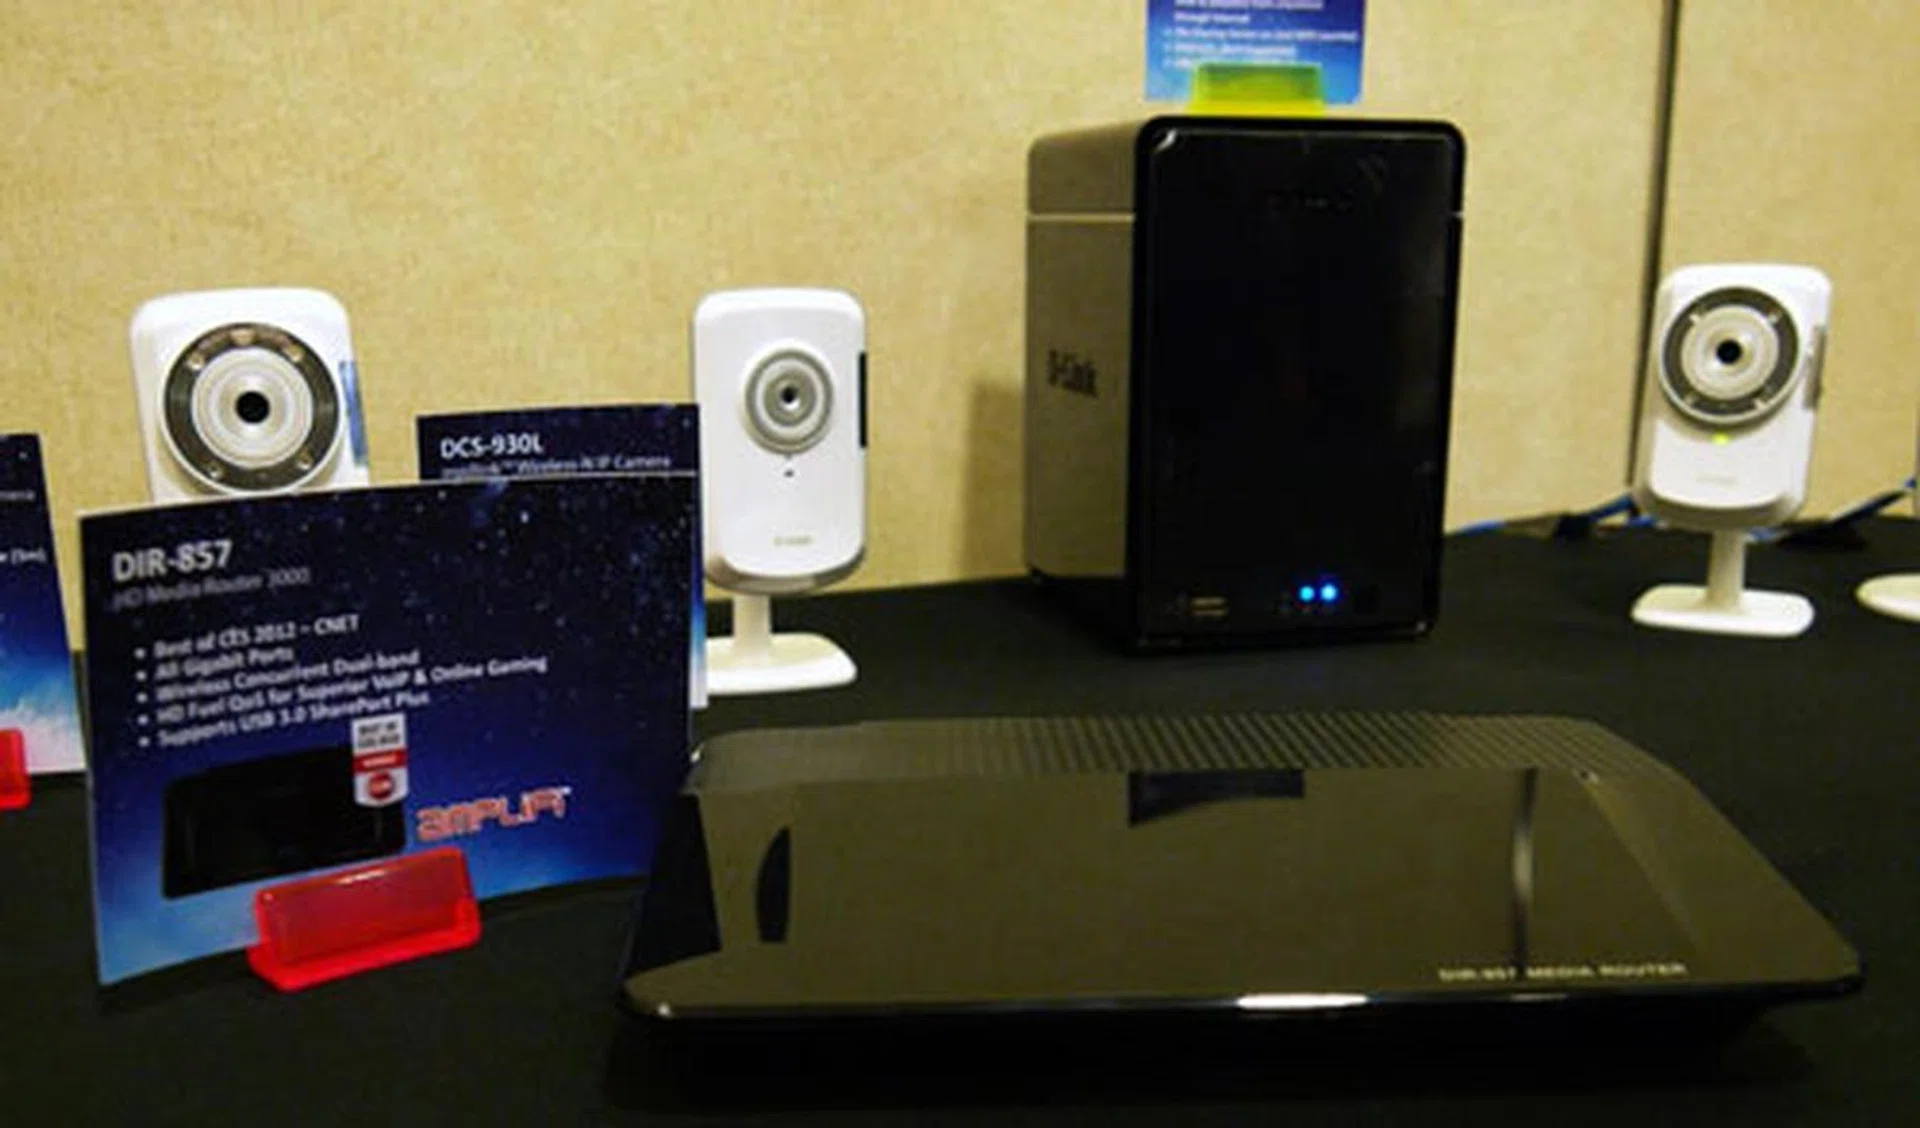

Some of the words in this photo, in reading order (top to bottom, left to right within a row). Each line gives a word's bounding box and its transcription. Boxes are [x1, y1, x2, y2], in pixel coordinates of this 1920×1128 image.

[440, 433, 544, 459] DCS-930L
[112, 538, 233, 582] DIR-857
[154, 638, 193, 658] Best
[197, 630, 217, 651] of
[218, 627, 250, 648] CES
[313, 614, 360, 636] CNET
[155, 660, 179, 680] All
[182, 651, 245, 678] Gigabit
[248, 647, 295, 666] Ports
[430, 662, 484, 683] Online
[487, 655, 548, 678] Gaming
[155, 677, 232, 702] Wireless
[238, 709, 276, 732] USB
[394, 690, 430, 708] Plus
